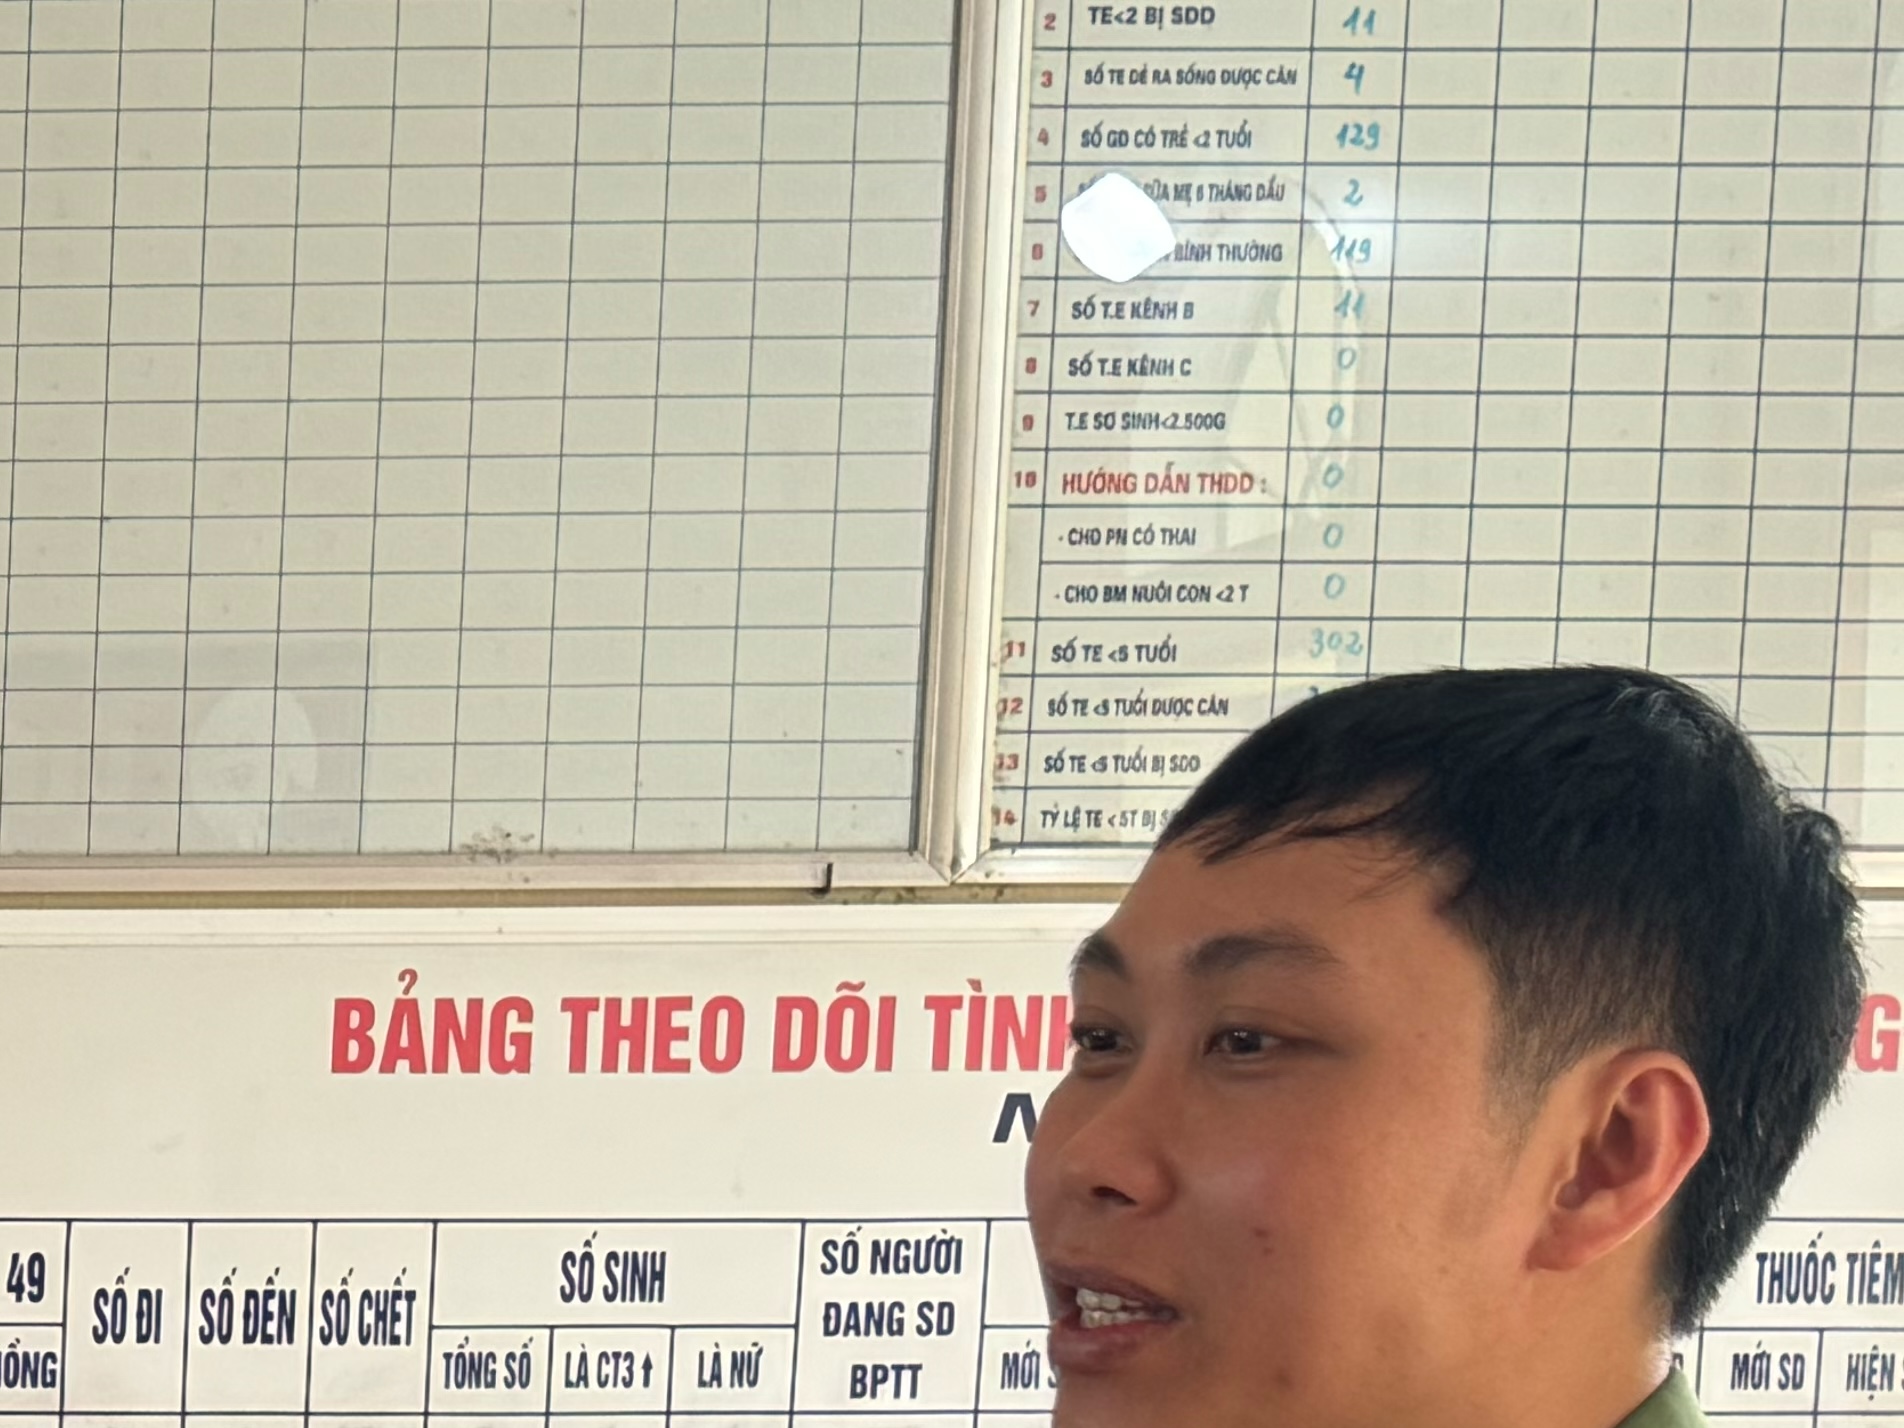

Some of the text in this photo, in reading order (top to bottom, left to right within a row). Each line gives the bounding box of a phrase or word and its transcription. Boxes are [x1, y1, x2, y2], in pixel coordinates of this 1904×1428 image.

[1335, 121, 1382, 151] 129
[1071, 294, 1096, 320] SỐ
[1130, 296, 1178, 320] KÊNH
[1182, 301, 1195, 320] B
[1062, 464, 1138, 495] HƯỚNG
[1196, 472, 1254, 494] THDD
[331, 967, 534, 1074] BẢNG
[559, 995, 745, 1073] THEO
[771, 981, 898, 1073] DÕI
[6, 1251, 46, 1304] 49
[559, 1232, 667, 1305] SỐ SINH
[820, 1227, 963, 1277] SỐ NGƯỜI
[1755, 1231, 1904, 1305] THUỐC TIÊM
[92, 1268, 163, 1346] SỐ ĐI
[198, 1267, 296, 1346] SỐ ĐẾN
[318, 1268, 417, 1347] SỐ CHẾT
[822, 1301, 956, 1338] ĐANG SD
[442, 1335, 534, 1391] TỔNG SỐ
[563, 1340, 636, 1391] LÀ CT3
[697, 1340, 764, 1390] LÀ NỮ
[848, 1362, 923, 1401] BPTT
[1000, 1342, 1042, 1391] MỚI
[1730, 1339, 1806, 1391] MỚI SD
[1845, 1344, 1894, 1401] HIỆN
